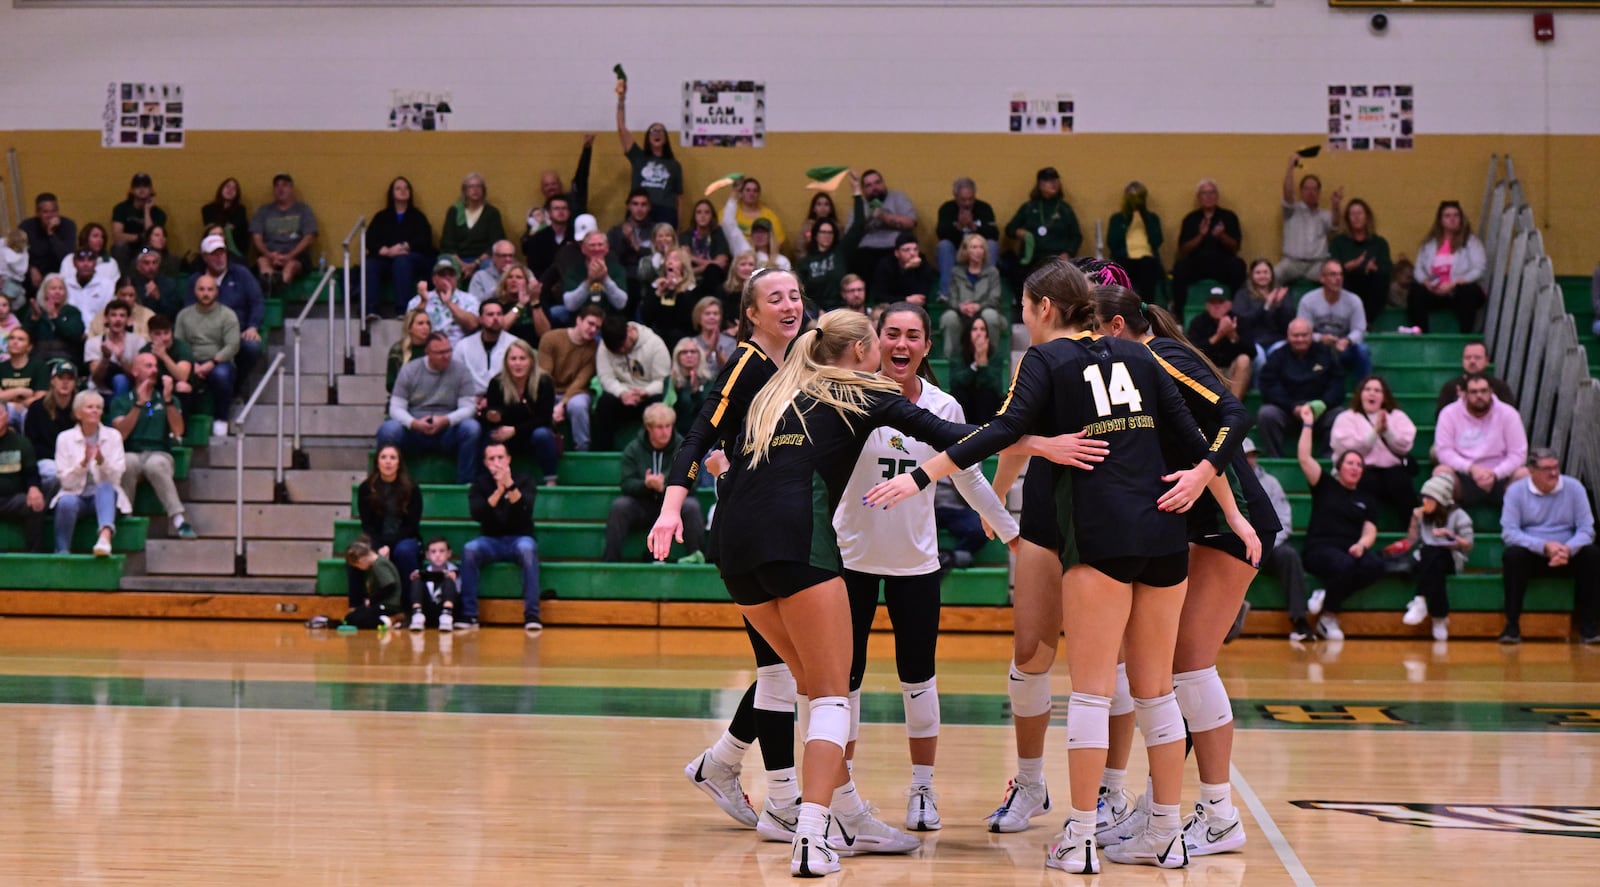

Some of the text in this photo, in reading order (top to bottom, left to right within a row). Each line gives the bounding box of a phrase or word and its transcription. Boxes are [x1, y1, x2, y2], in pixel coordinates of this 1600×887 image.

[708, 106, 735, 116] CAM
[1083, 361, 1143, 417] 14
[1083, 417, 1127, 437] WRIGHT
[771, 433, 806, 447] STATE
